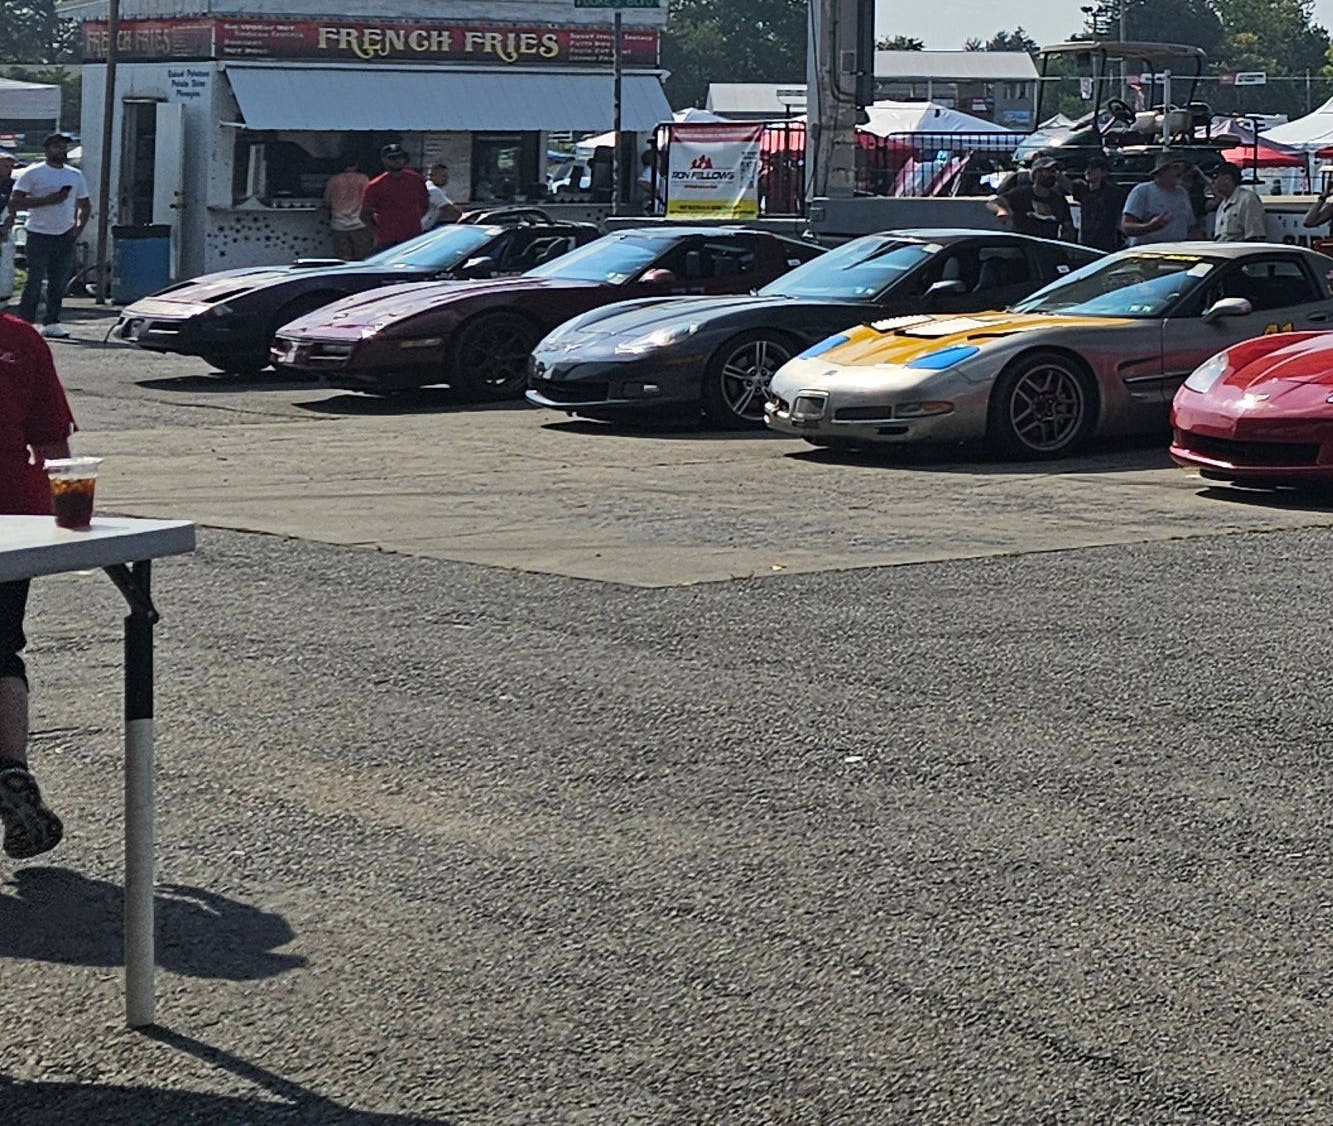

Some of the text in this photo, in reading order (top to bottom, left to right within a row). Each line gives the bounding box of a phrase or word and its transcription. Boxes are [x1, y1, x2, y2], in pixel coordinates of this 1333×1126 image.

[317, 27, 452, 60] FRENCH
[464, 31, 561, 63] FRIES
[671, 171, 735, 180] RON FELLOWS
